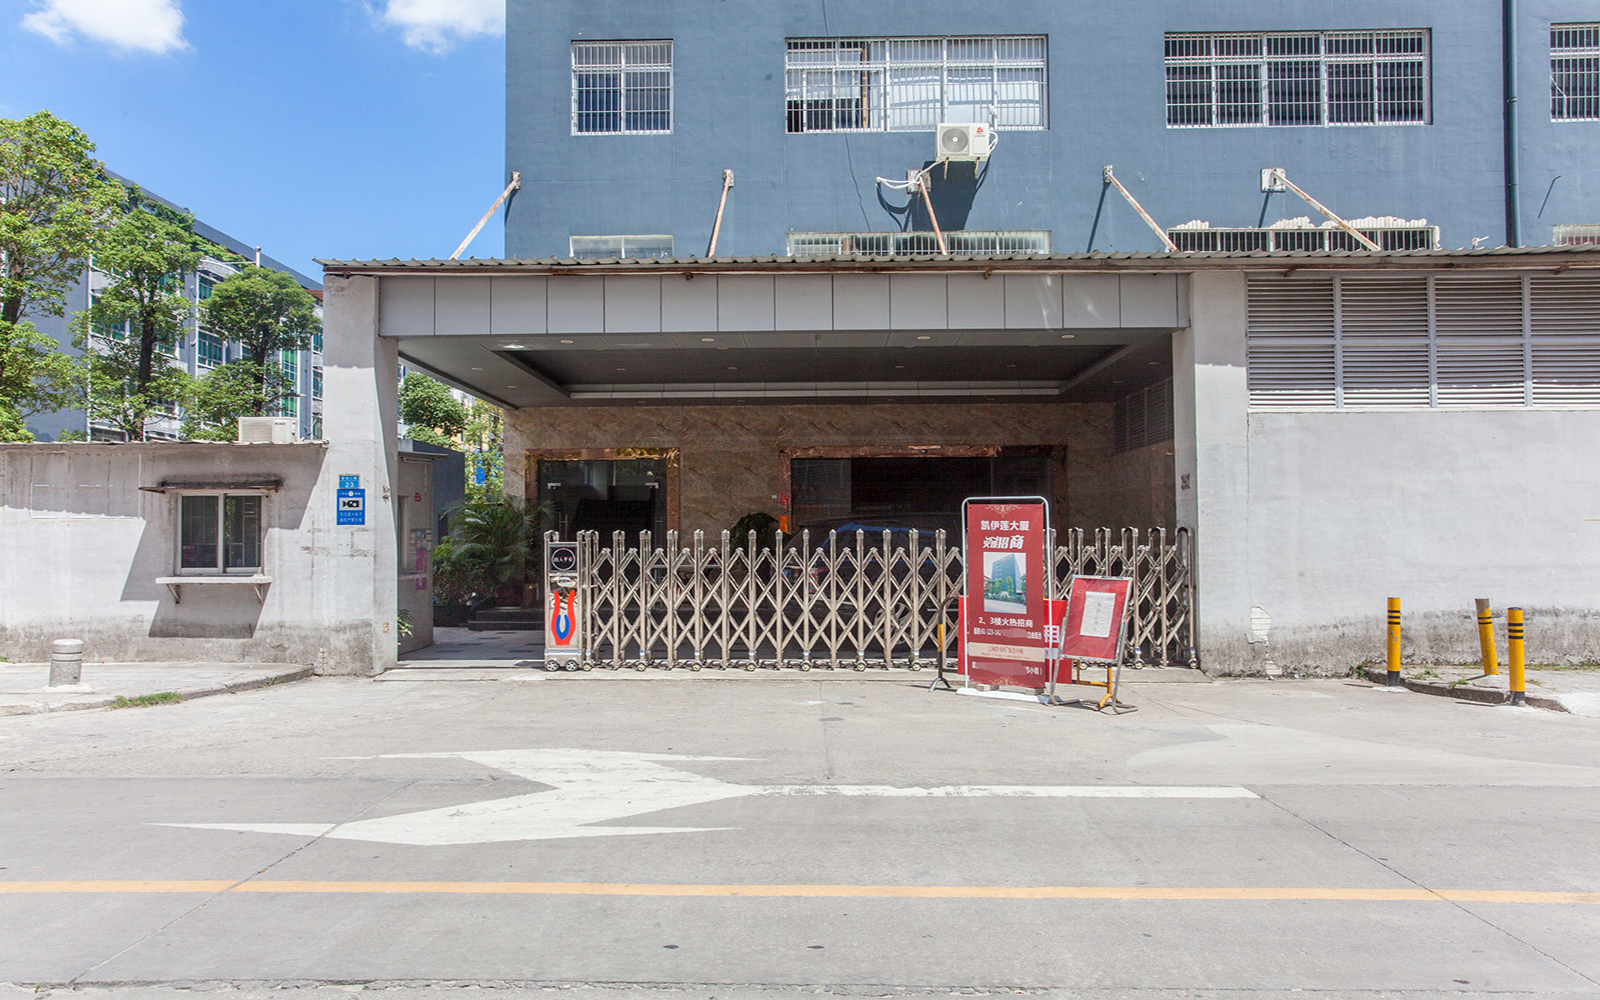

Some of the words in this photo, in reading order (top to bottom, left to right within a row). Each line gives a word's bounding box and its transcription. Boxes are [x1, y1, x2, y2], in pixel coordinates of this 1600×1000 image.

[980, 520, 1030, 531] 凯伊莲大厦
